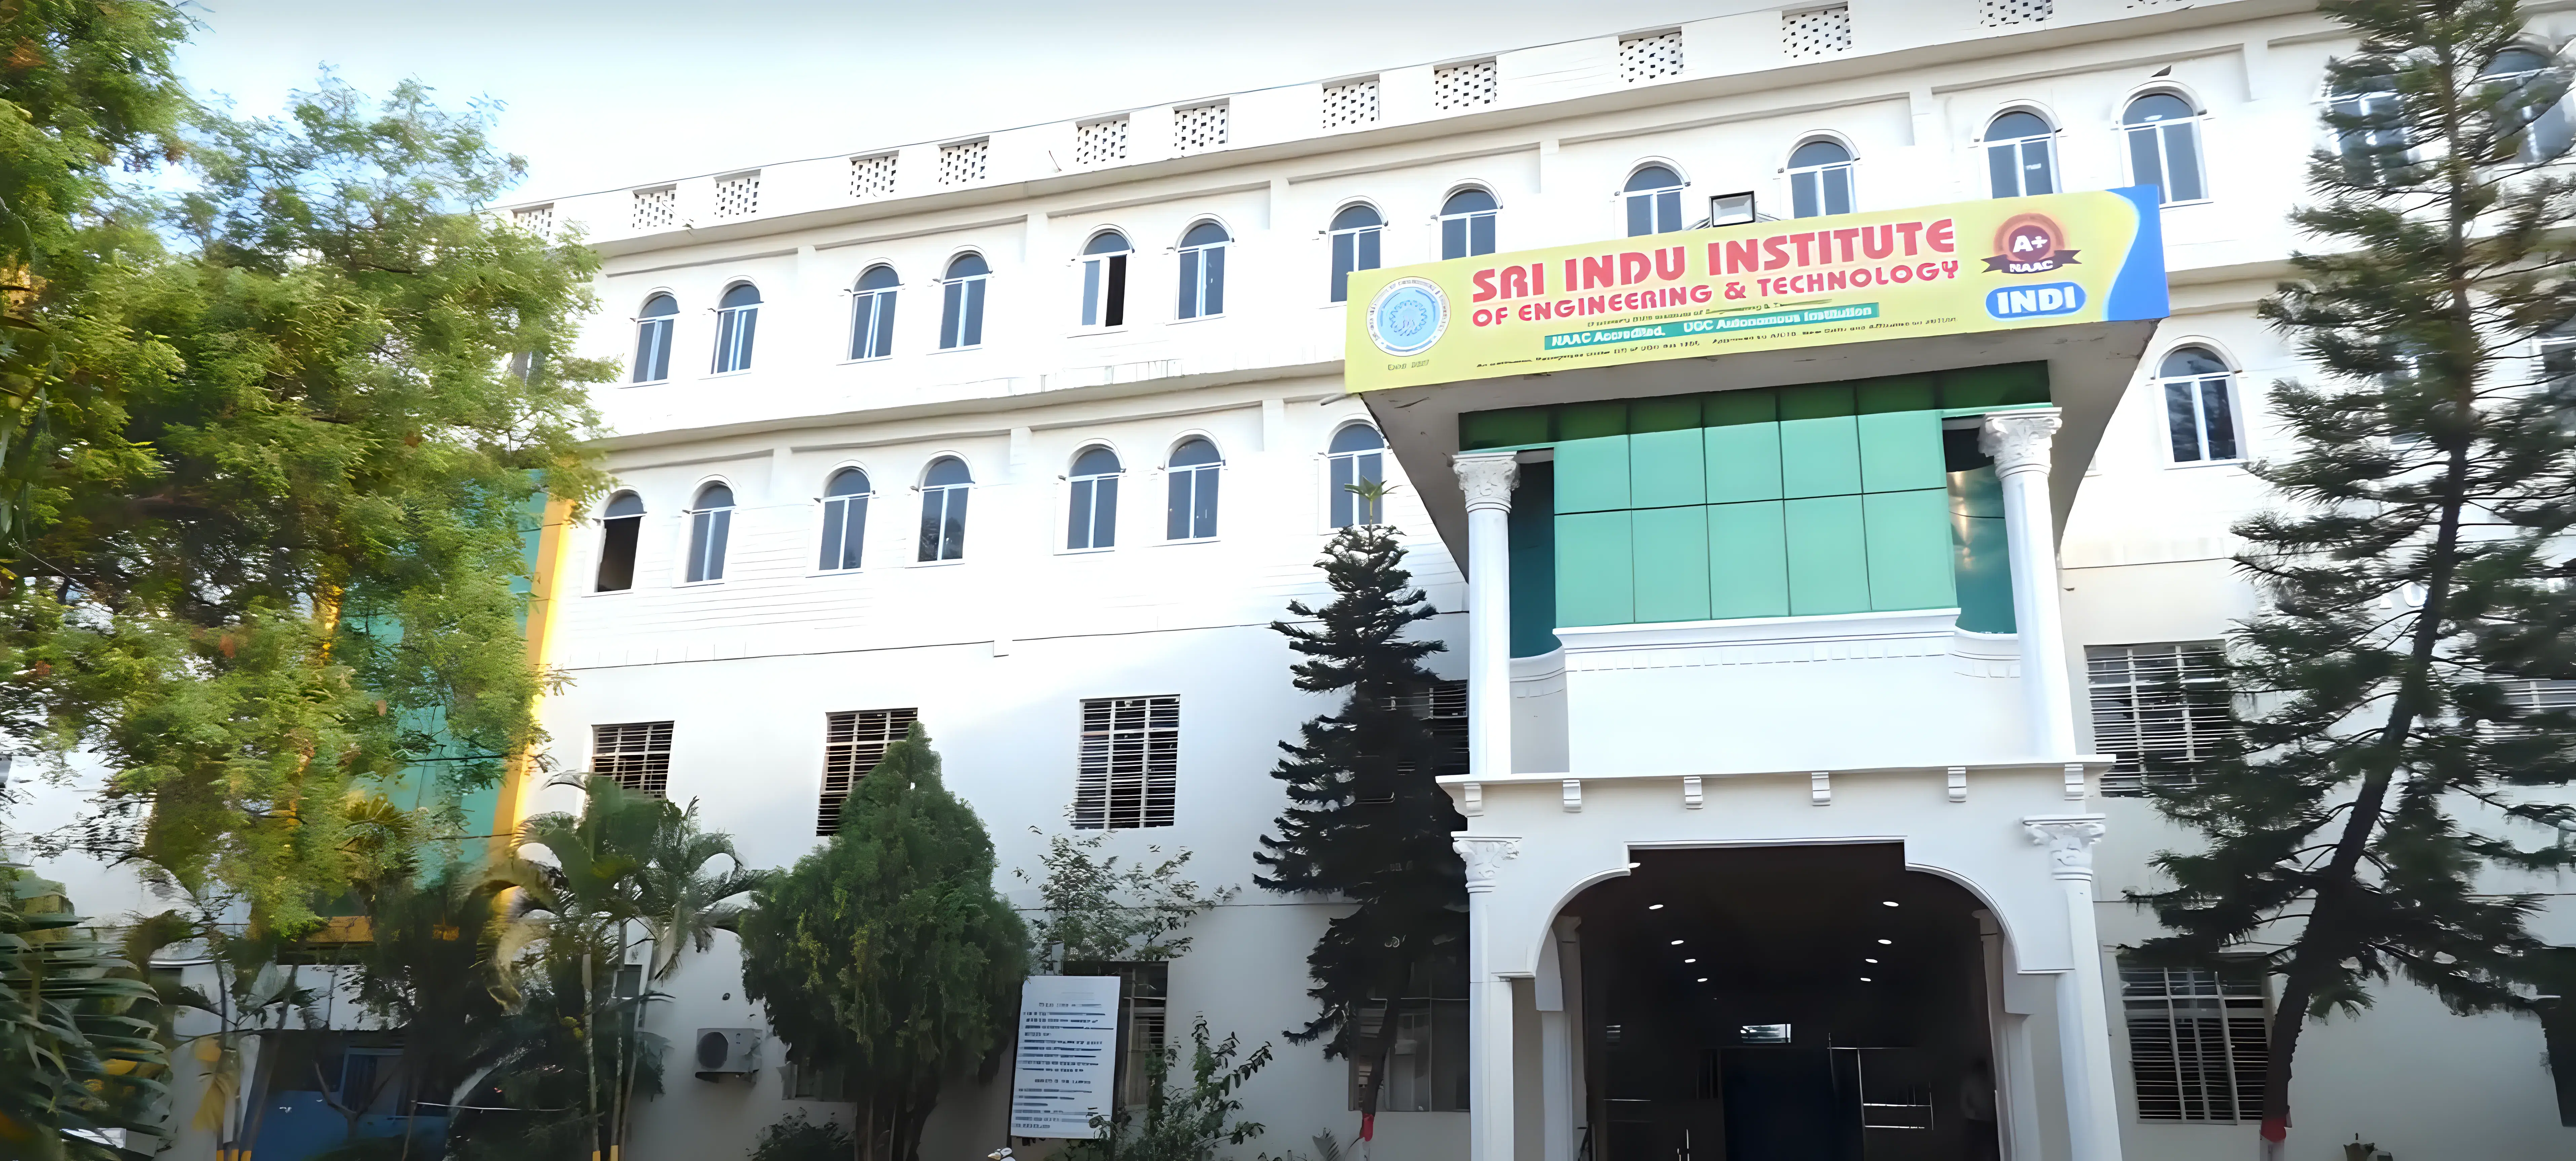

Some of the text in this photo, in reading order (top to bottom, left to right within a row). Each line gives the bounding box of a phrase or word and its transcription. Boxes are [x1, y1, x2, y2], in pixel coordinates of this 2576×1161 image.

[2013, 235, 2048, 252] A+
[1473, 219, 1954, 303] SRI INDU INSTITUTE
[2009, 260, 2053, 272] NAAC
[1473, 307, 1508, 327] OF
[1518, 285, 1712, 321] ENGINEERING
[1725, 282, 1746, 300] &
[1756, 260, 1959, 297] TECHNOLOGY
[1997, 286, 2076, 314] INDI
